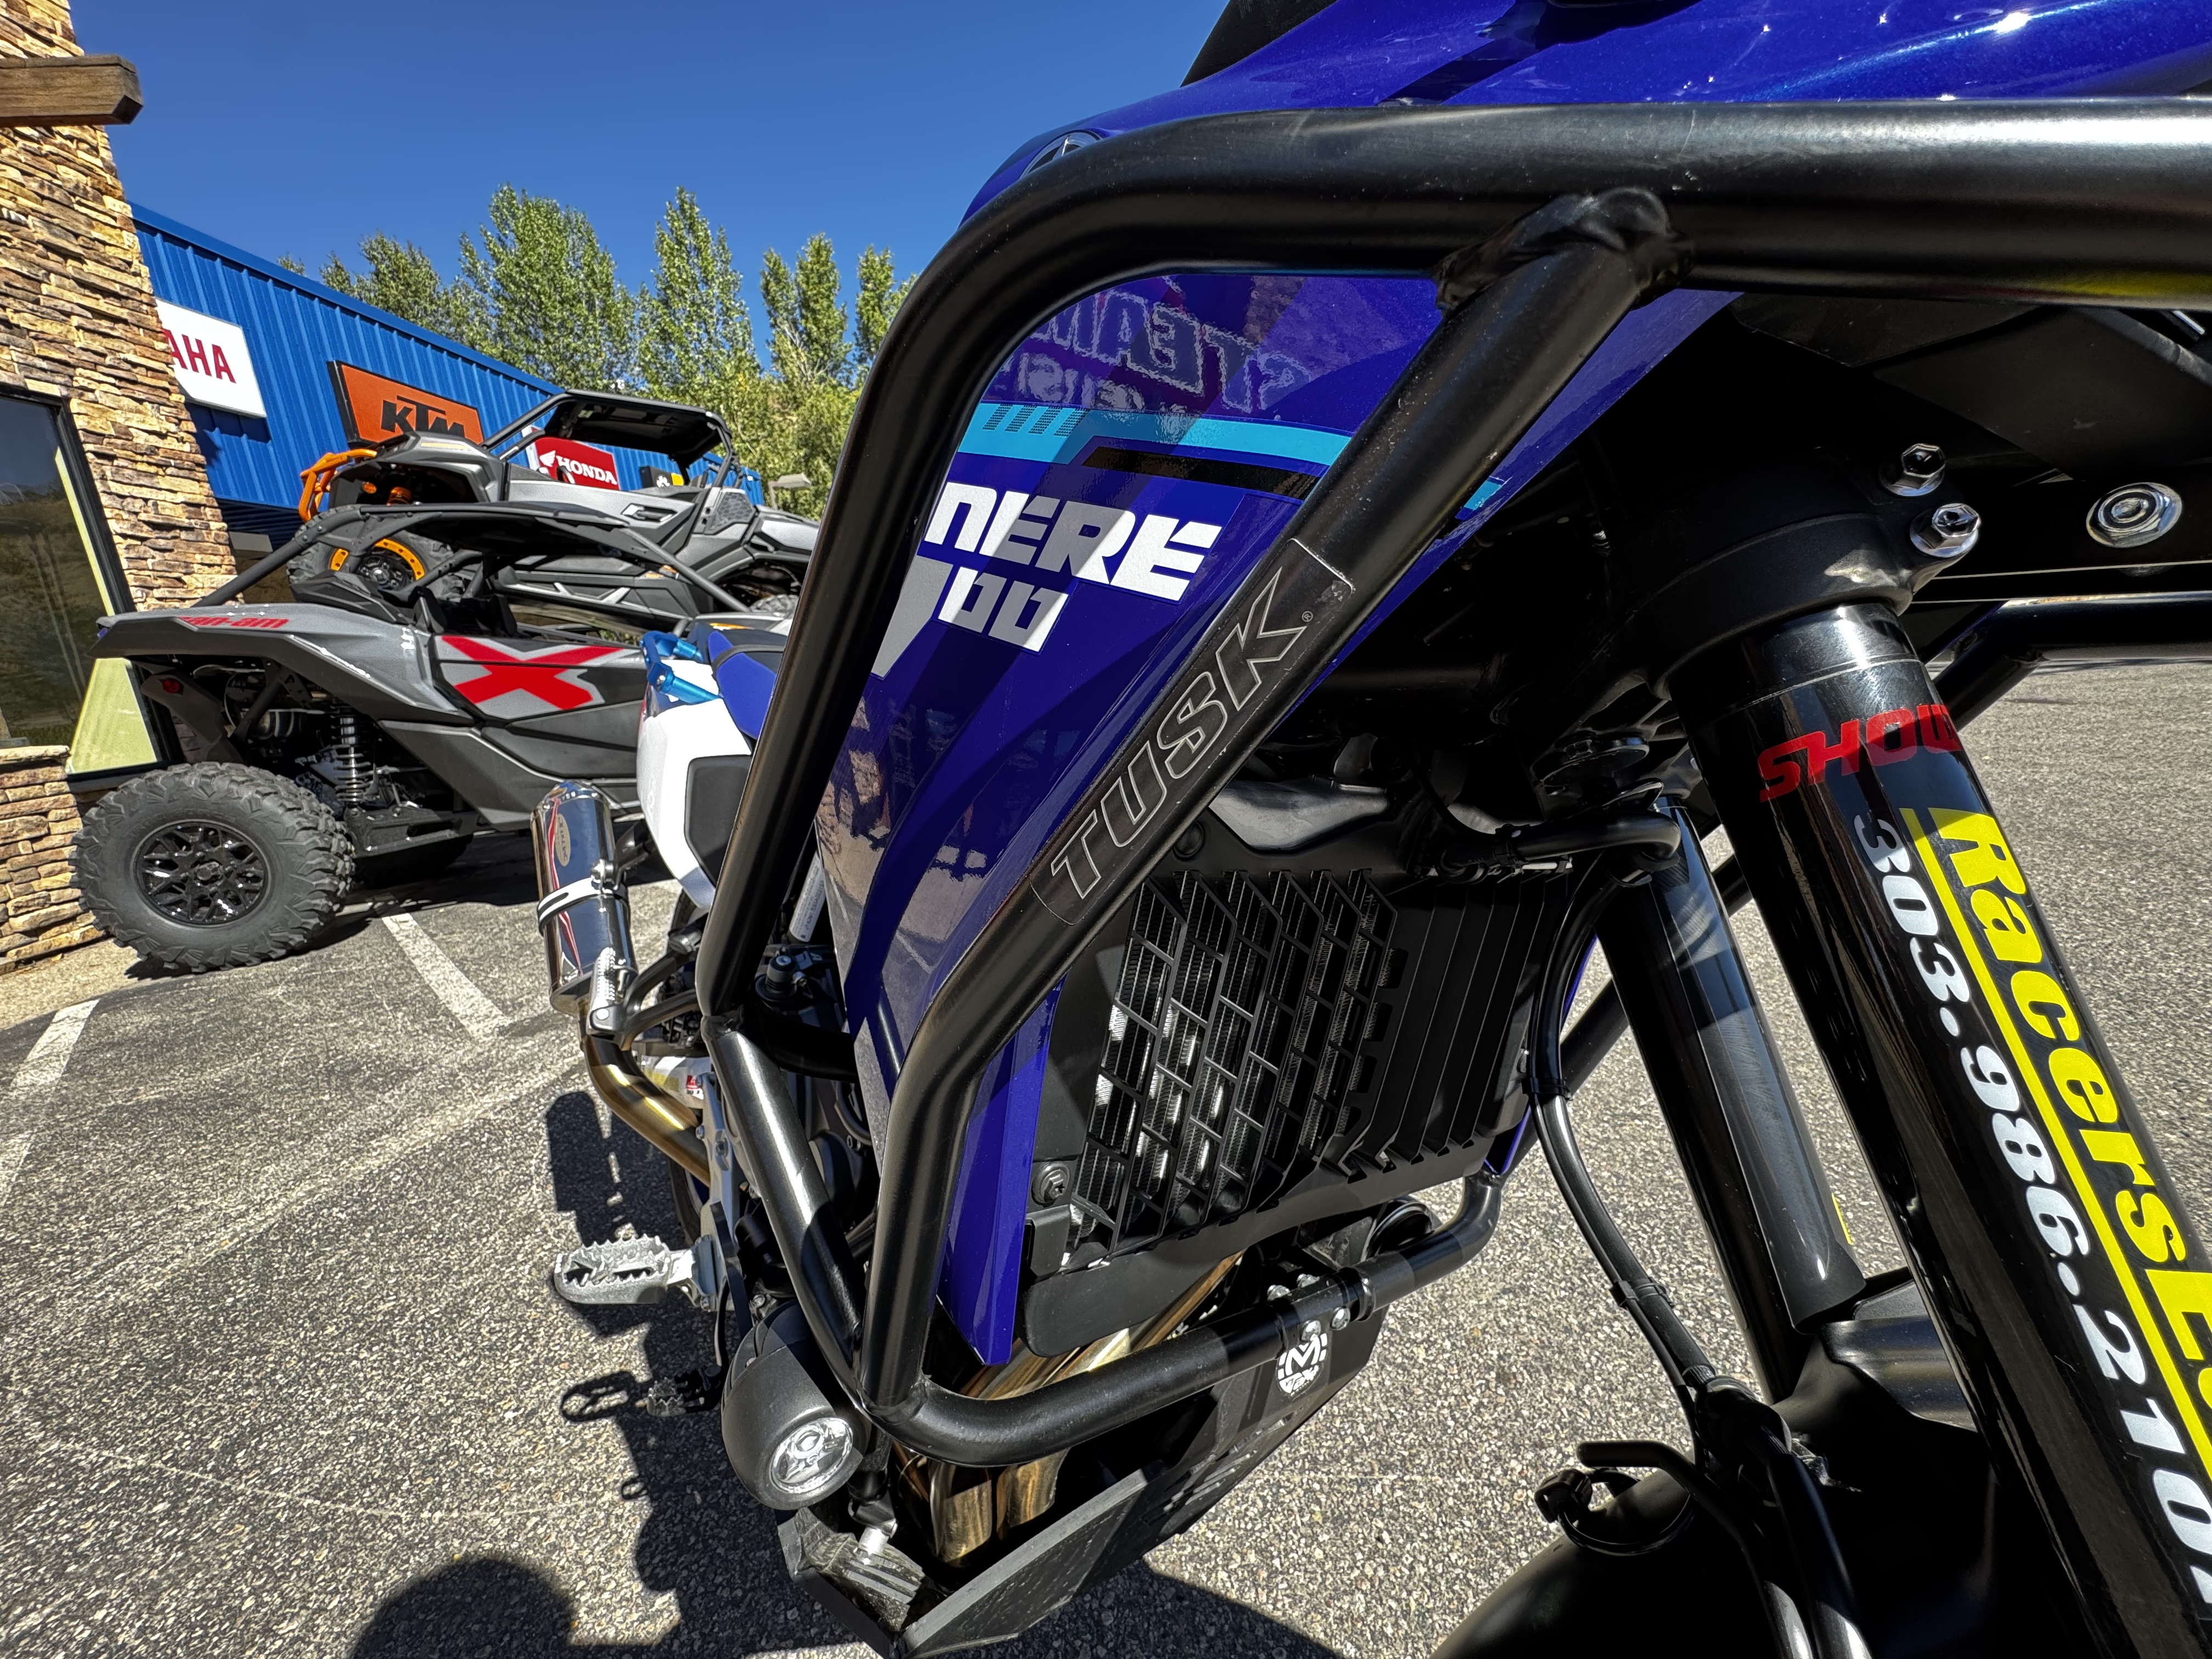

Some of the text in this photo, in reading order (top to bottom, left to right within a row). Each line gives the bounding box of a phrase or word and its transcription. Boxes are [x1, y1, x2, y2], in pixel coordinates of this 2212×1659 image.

[381, 395, 466, 437] KTM
[556, 455, 617, 486] HONDA
[924, 481, 1222, 601] NERE
